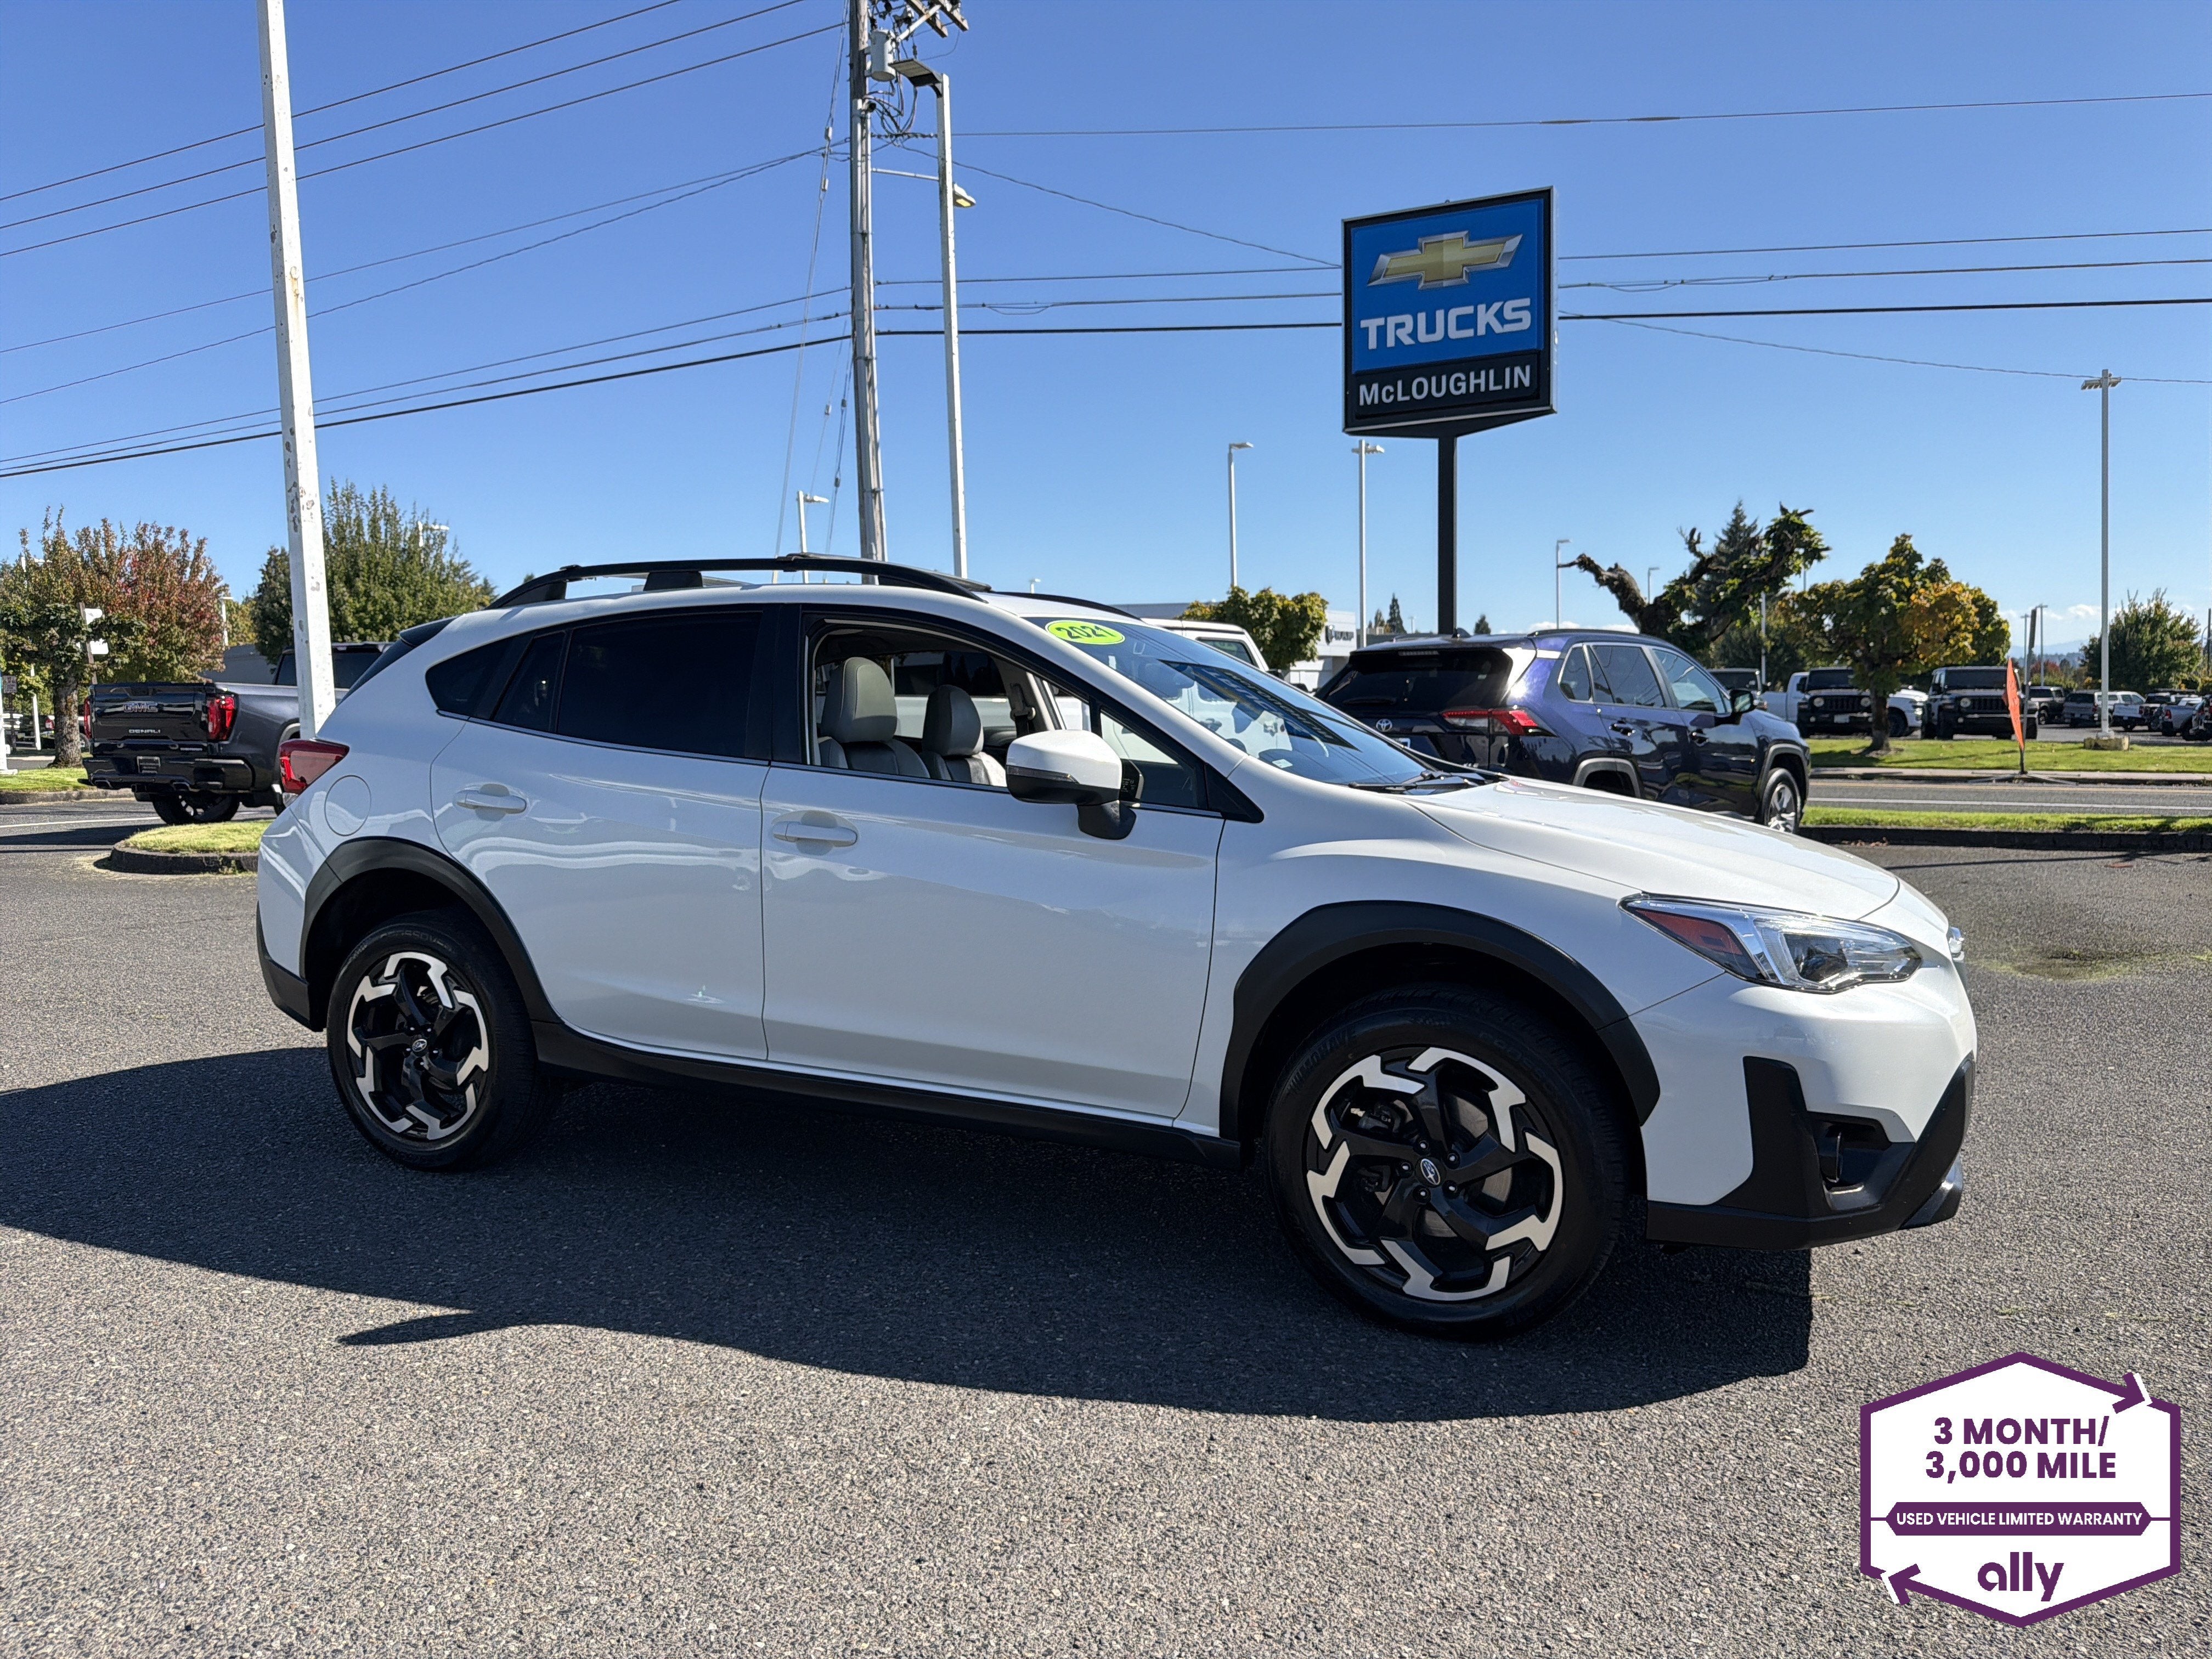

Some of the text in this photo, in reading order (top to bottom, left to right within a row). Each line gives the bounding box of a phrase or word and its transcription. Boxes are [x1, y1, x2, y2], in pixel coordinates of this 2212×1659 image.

[1361, 298, 1531, 349] TRUCKS
[1359, 365, 1531, 406] McLOUGHLIN
[1055, 625, 1116, 639] 2021
[123, 702, 158, 713] GMC
